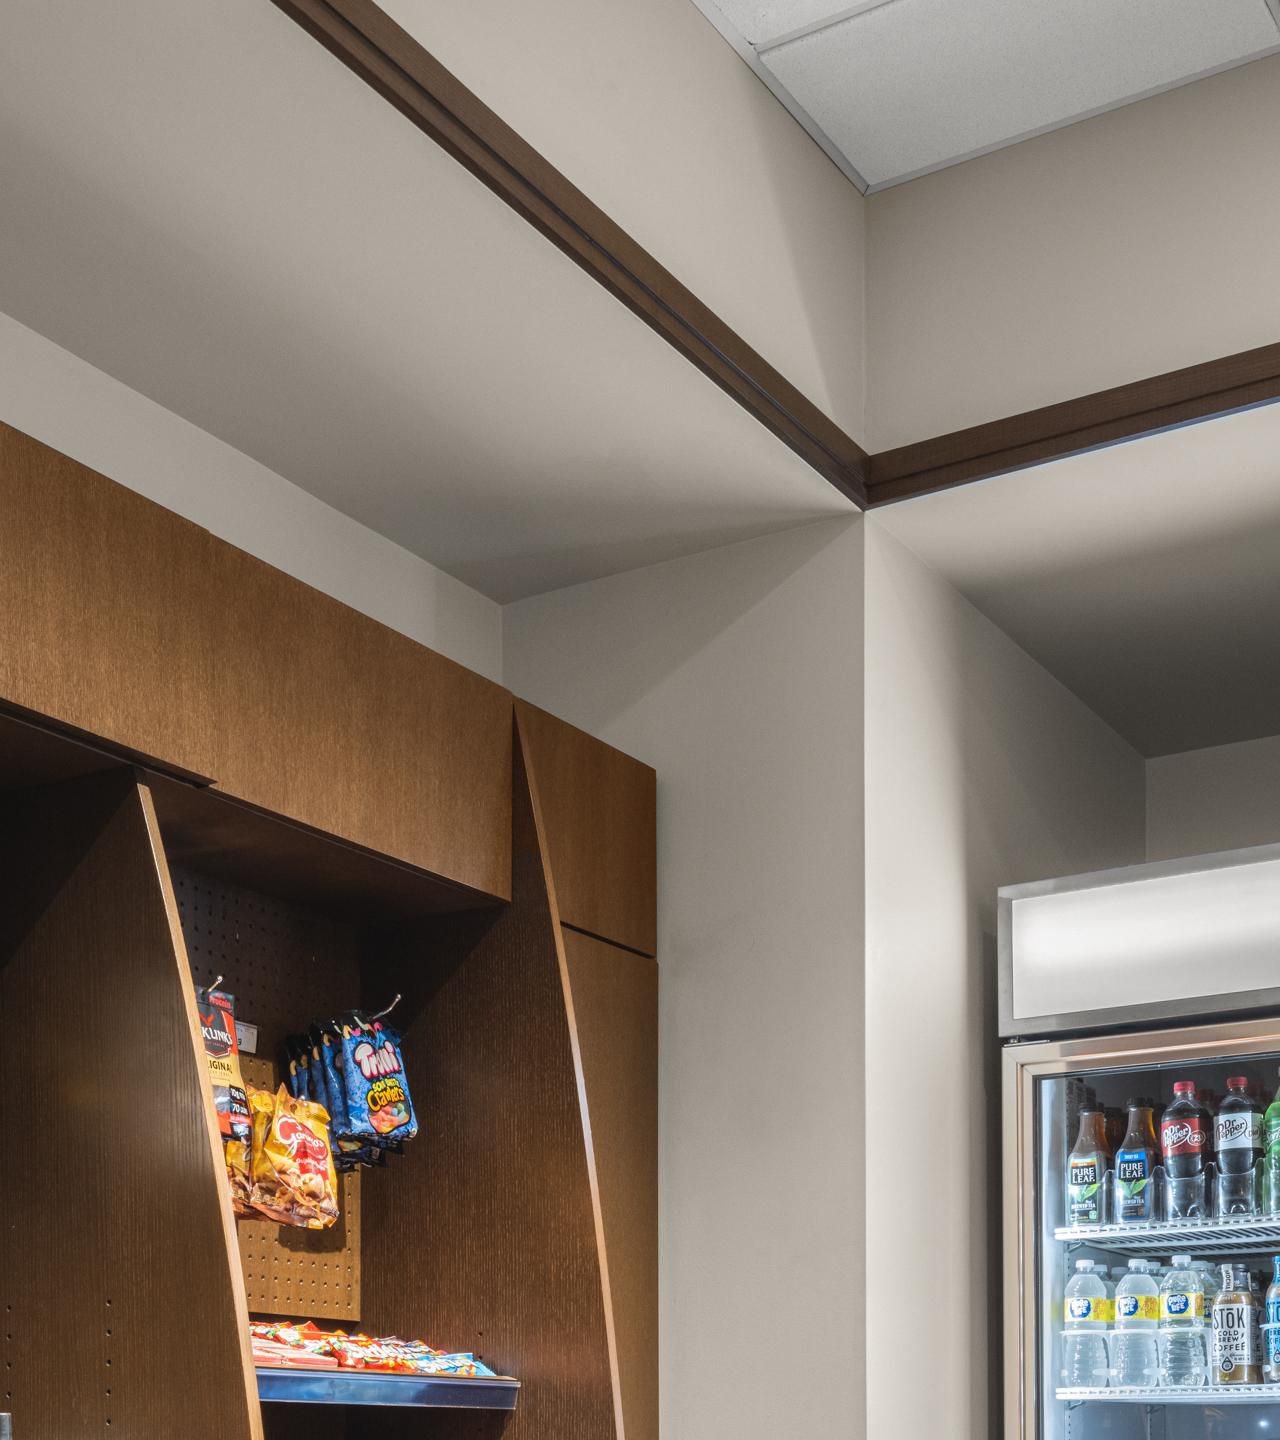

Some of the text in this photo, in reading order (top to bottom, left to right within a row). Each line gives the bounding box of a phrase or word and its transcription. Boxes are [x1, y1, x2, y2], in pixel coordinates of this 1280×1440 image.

[1225, 1119, 1237, 1129] Dr
[1217, 1122, 1246, 1138] Pepper
[1121, 1162, 1143, 1171] PURE
[1072, 1167, 1094, 1176] PURE
